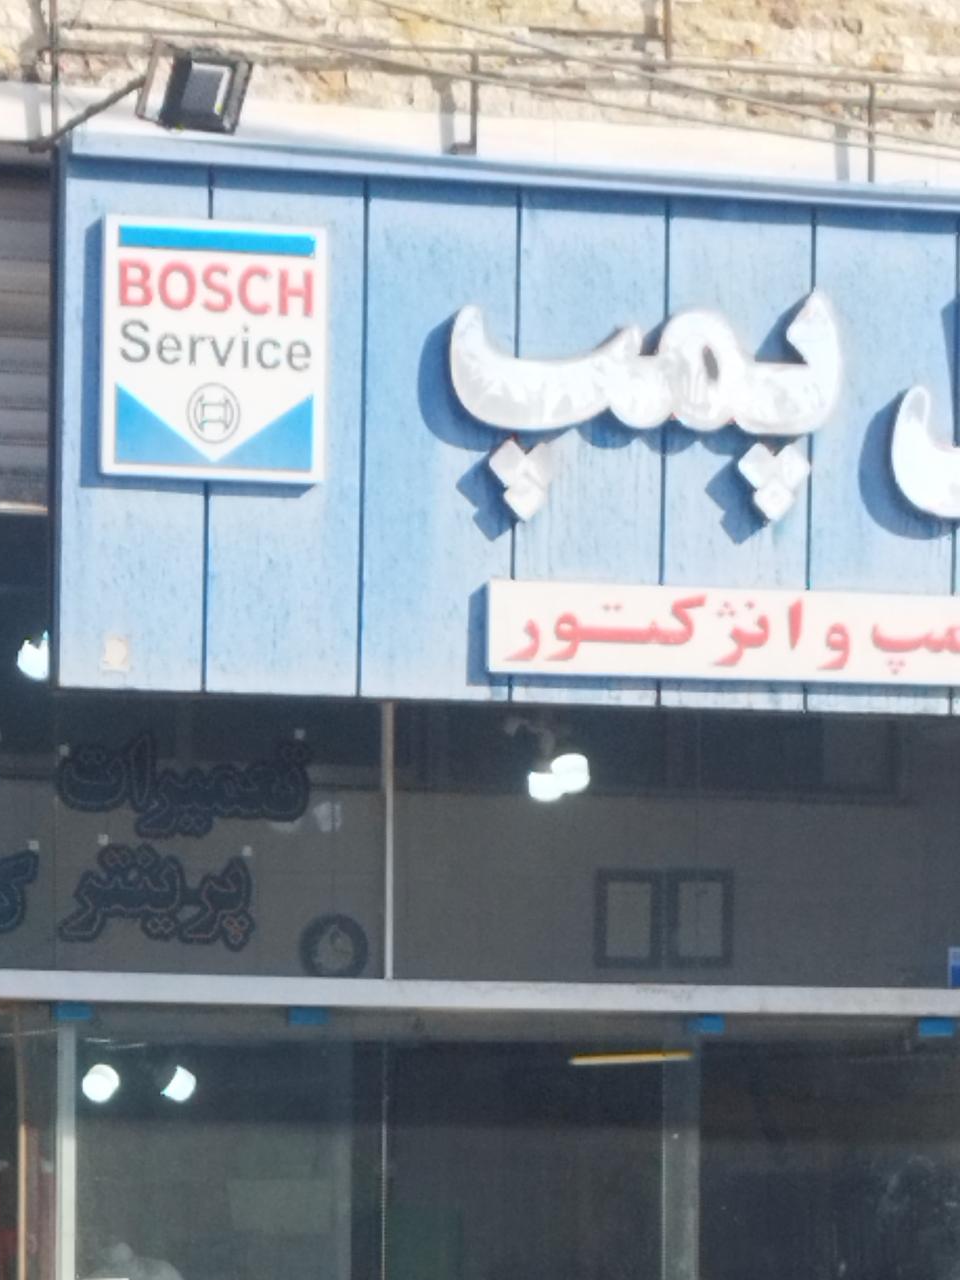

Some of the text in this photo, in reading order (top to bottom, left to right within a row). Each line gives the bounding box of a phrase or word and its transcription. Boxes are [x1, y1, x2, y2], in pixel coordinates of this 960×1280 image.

[118, 258, 315, 318] BOSCH
[119, 318, 313, 373] Service
[449, 286, 841, 524] پمپ
[502, 594, 804, 669] انژکتور
[816, 620, 852, 671] و
[58, 844, 255, 951] پرینتر
